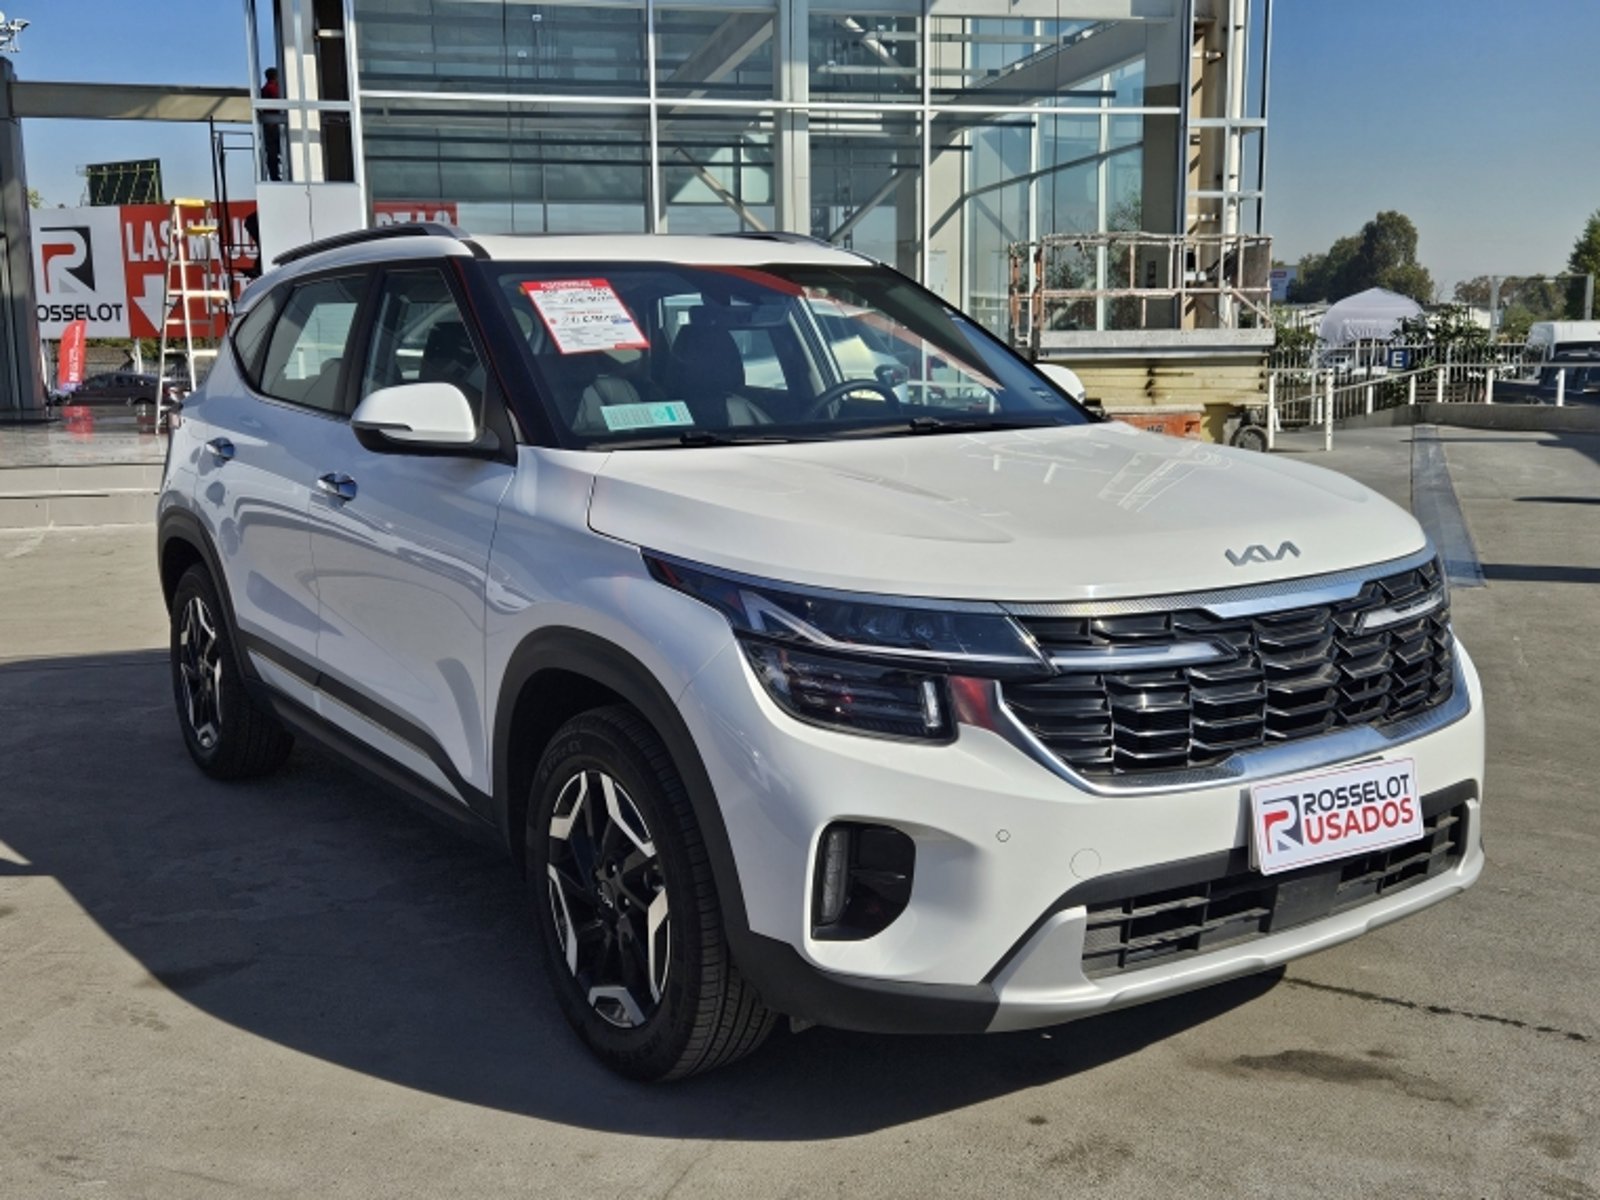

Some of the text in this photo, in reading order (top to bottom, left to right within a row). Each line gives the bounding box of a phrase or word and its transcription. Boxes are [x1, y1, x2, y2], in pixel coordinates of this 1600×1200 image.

[125, 219, 178, 262] LAS
[36, 303, 123, 322] OSSELOT
[1391, 351, 1405, 368] E
[1224, 541, 1302, 567] KIA
[1302, 773, 1410, 816] ROSSELOT
[1304, 797, 1414, 845] USADOS
